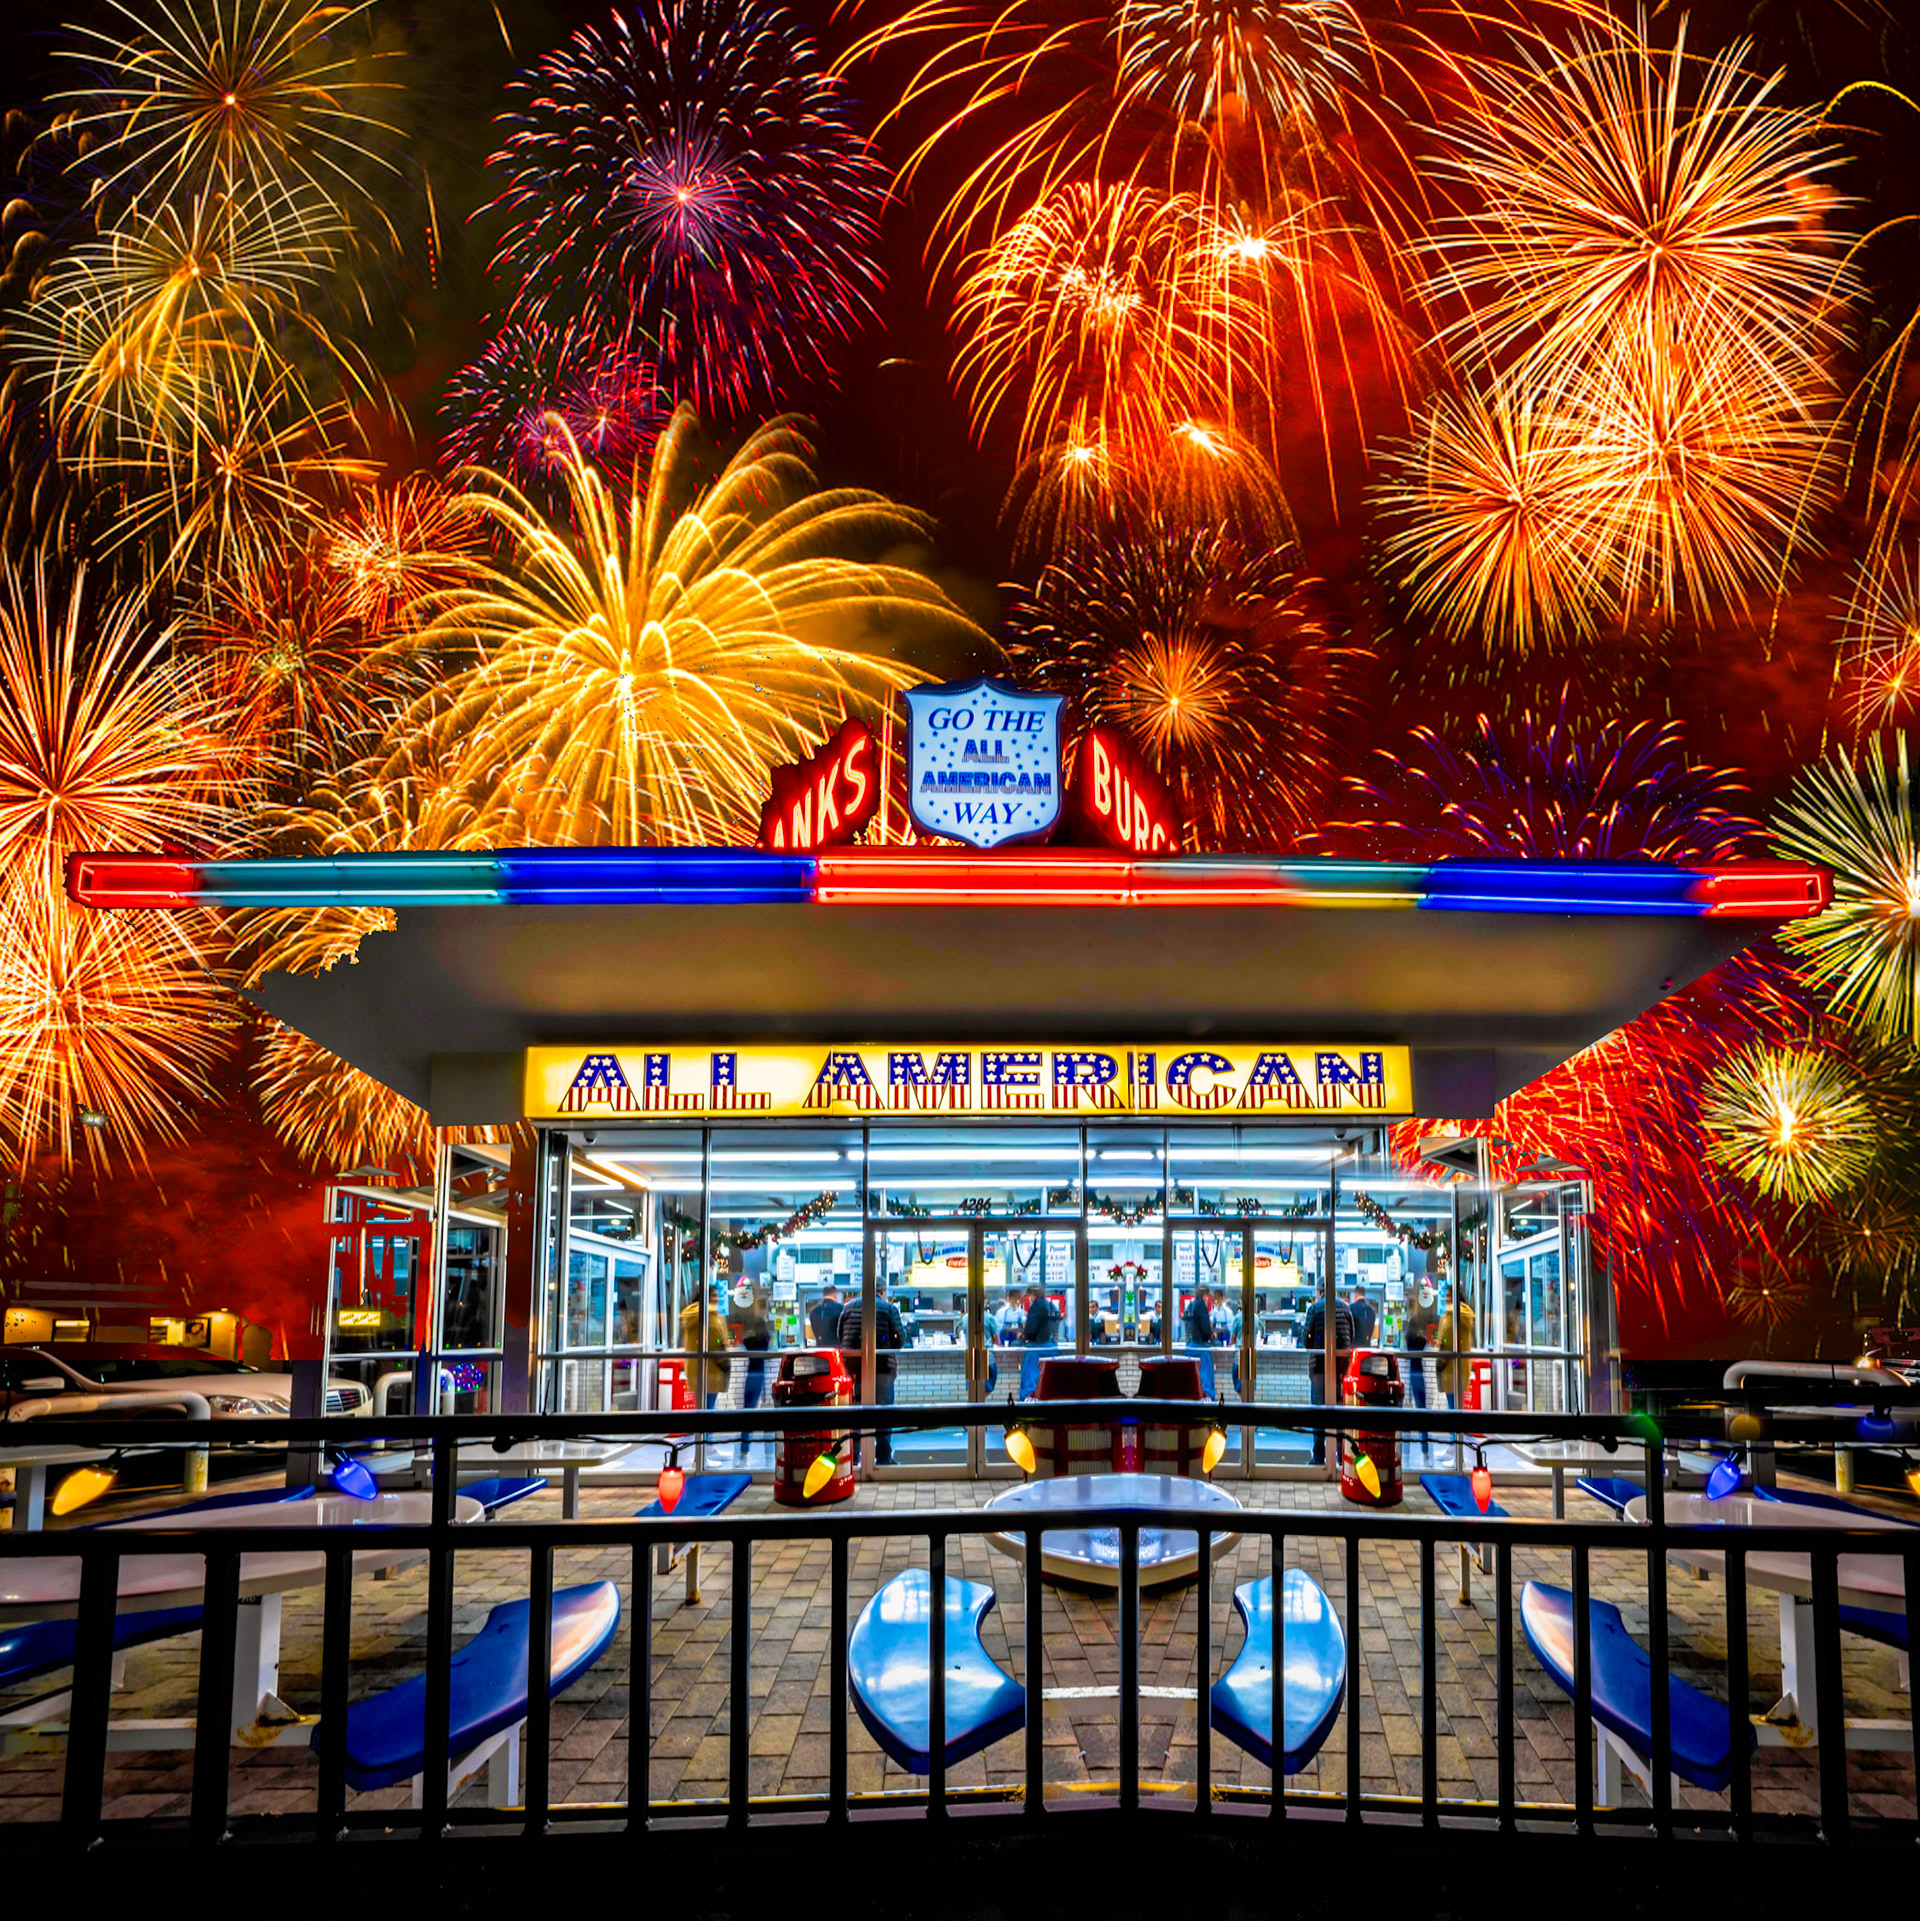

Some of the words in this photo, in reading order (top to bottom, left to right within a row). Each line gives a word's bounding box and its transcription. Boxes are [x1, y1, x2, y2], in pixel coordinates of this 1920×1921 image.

[928, 707, 975, 731] GO
[983, 709, 1046, 732] THE
[961, 738, 1010, 764] ALL
[757, 735, 867, 848] ANKS
[919, 770, 1052, 795] AMERICAN
[954, 802, 1023, 824] WAY
[557, 1052, 771, 1112] ALL
[802, 1051, 1386, 1110] AMERICAN
[958, 1197, 992, 1211] 4286
